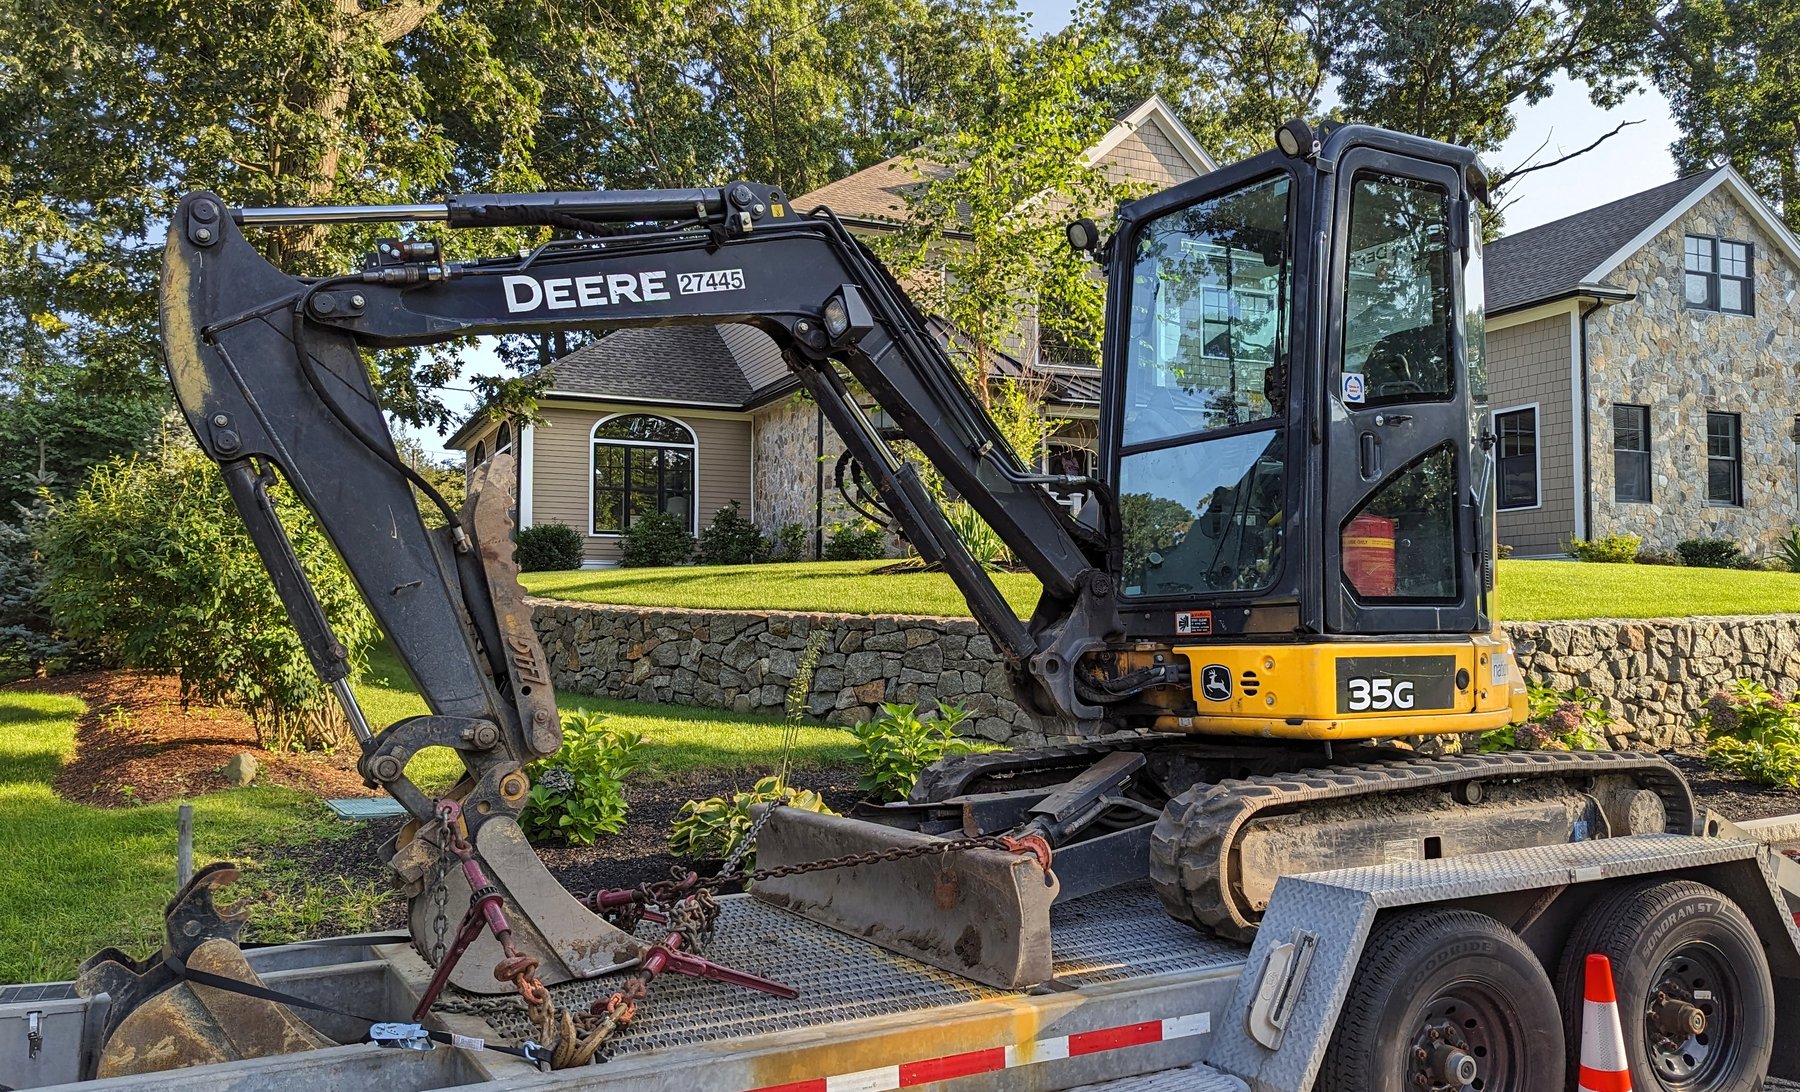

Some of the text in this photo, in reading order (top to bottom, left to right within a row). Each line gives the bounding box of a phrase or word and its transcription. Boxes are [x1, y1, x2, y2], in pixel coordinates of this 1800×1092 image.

[502, 271, 743, 313] DEERE 27445
[1349, 678, 1414, 710] 35G
[1642, 903, 1713, 957] SONORAN ST
[1402, 942, 1492, 997] GOODRIDE
